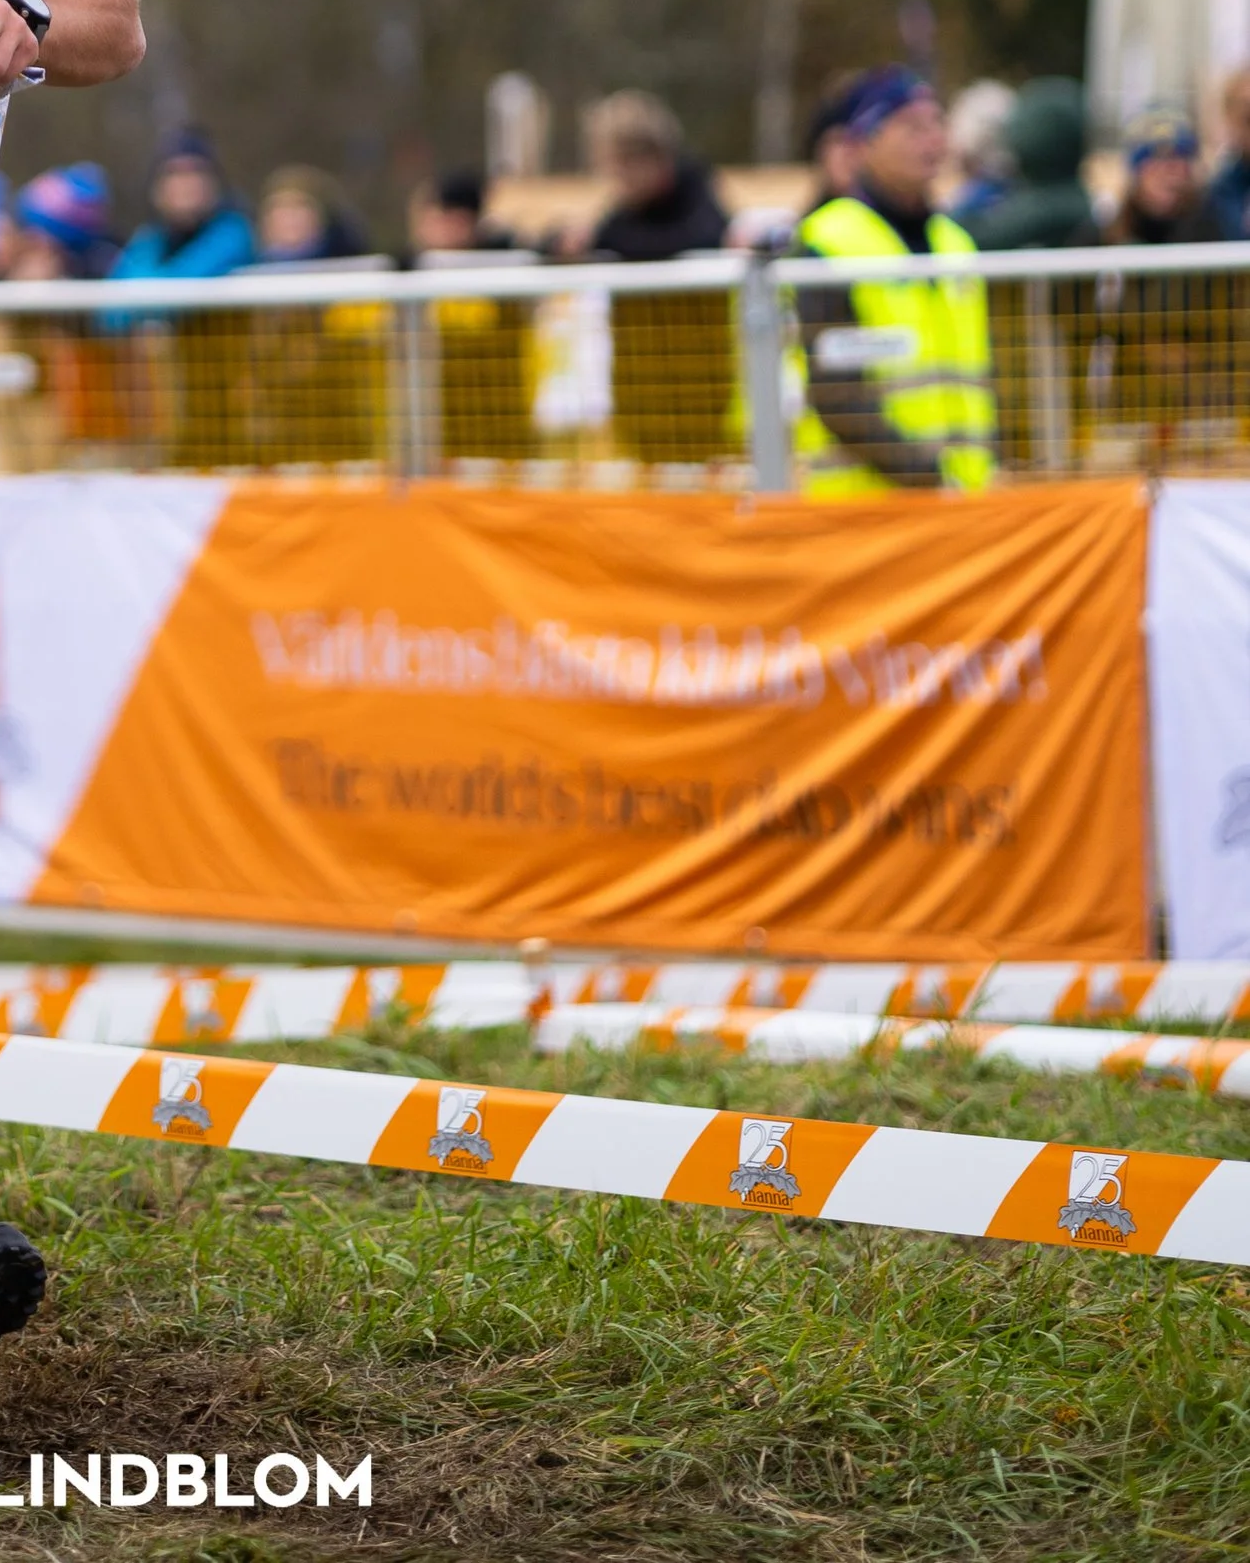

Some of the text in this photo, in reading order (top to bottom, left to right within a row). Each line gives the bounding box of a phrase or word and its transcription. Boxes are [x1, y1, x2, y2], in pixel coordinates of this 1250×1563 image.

[441, 1089, 483, 1136] 25
[743, 1122, 788, 1172] 25
[1074, 1155, 1122, 1207] 25
